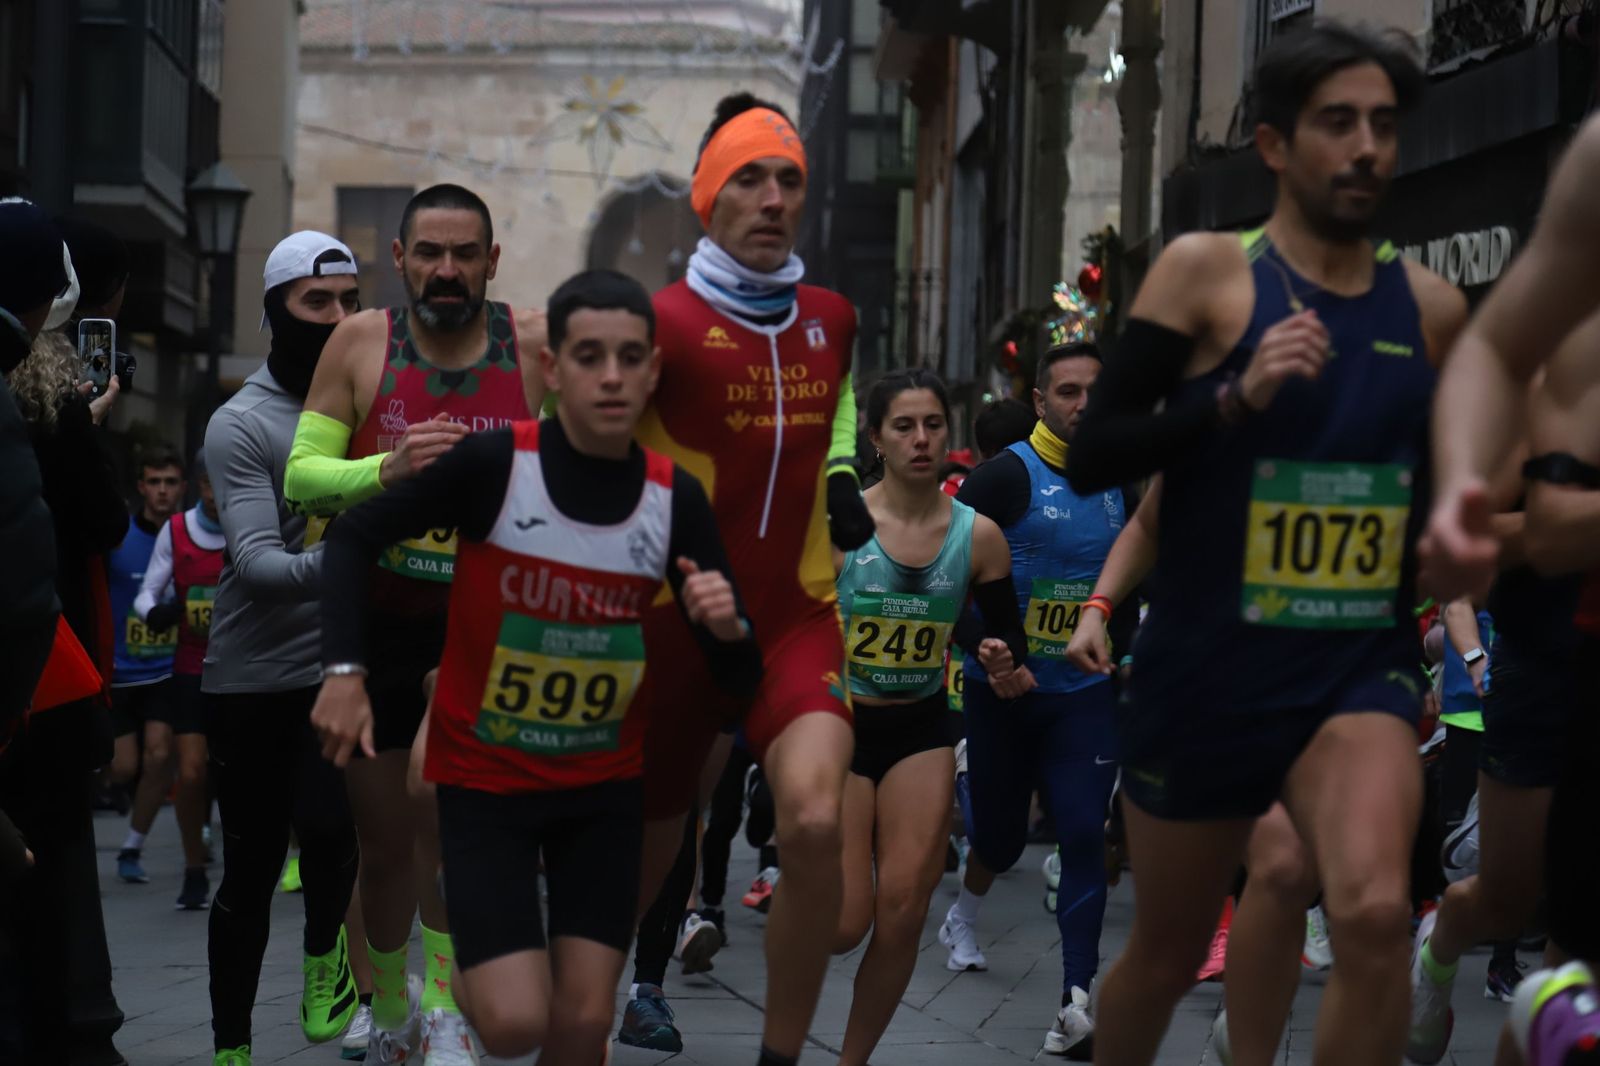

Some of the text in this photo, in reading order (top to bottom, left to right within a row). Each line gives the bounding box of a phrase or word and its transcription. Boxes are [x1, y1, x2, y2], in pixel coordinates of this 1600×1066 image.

[747, 364, 808, 382] VINO
[727, 380, 829, 402] DE TORO
[1264, 510, 1383, 575] 1073
[407, 557, 438, 574] CAJA
[882, 604, 928, 615] CAJA RURAL
[853, 621, 935, 662] 249
[872, 673, 898, 684] CAJA
[494, 663, 617, 722] 599
[519, 728, 560, 747] CAJA
